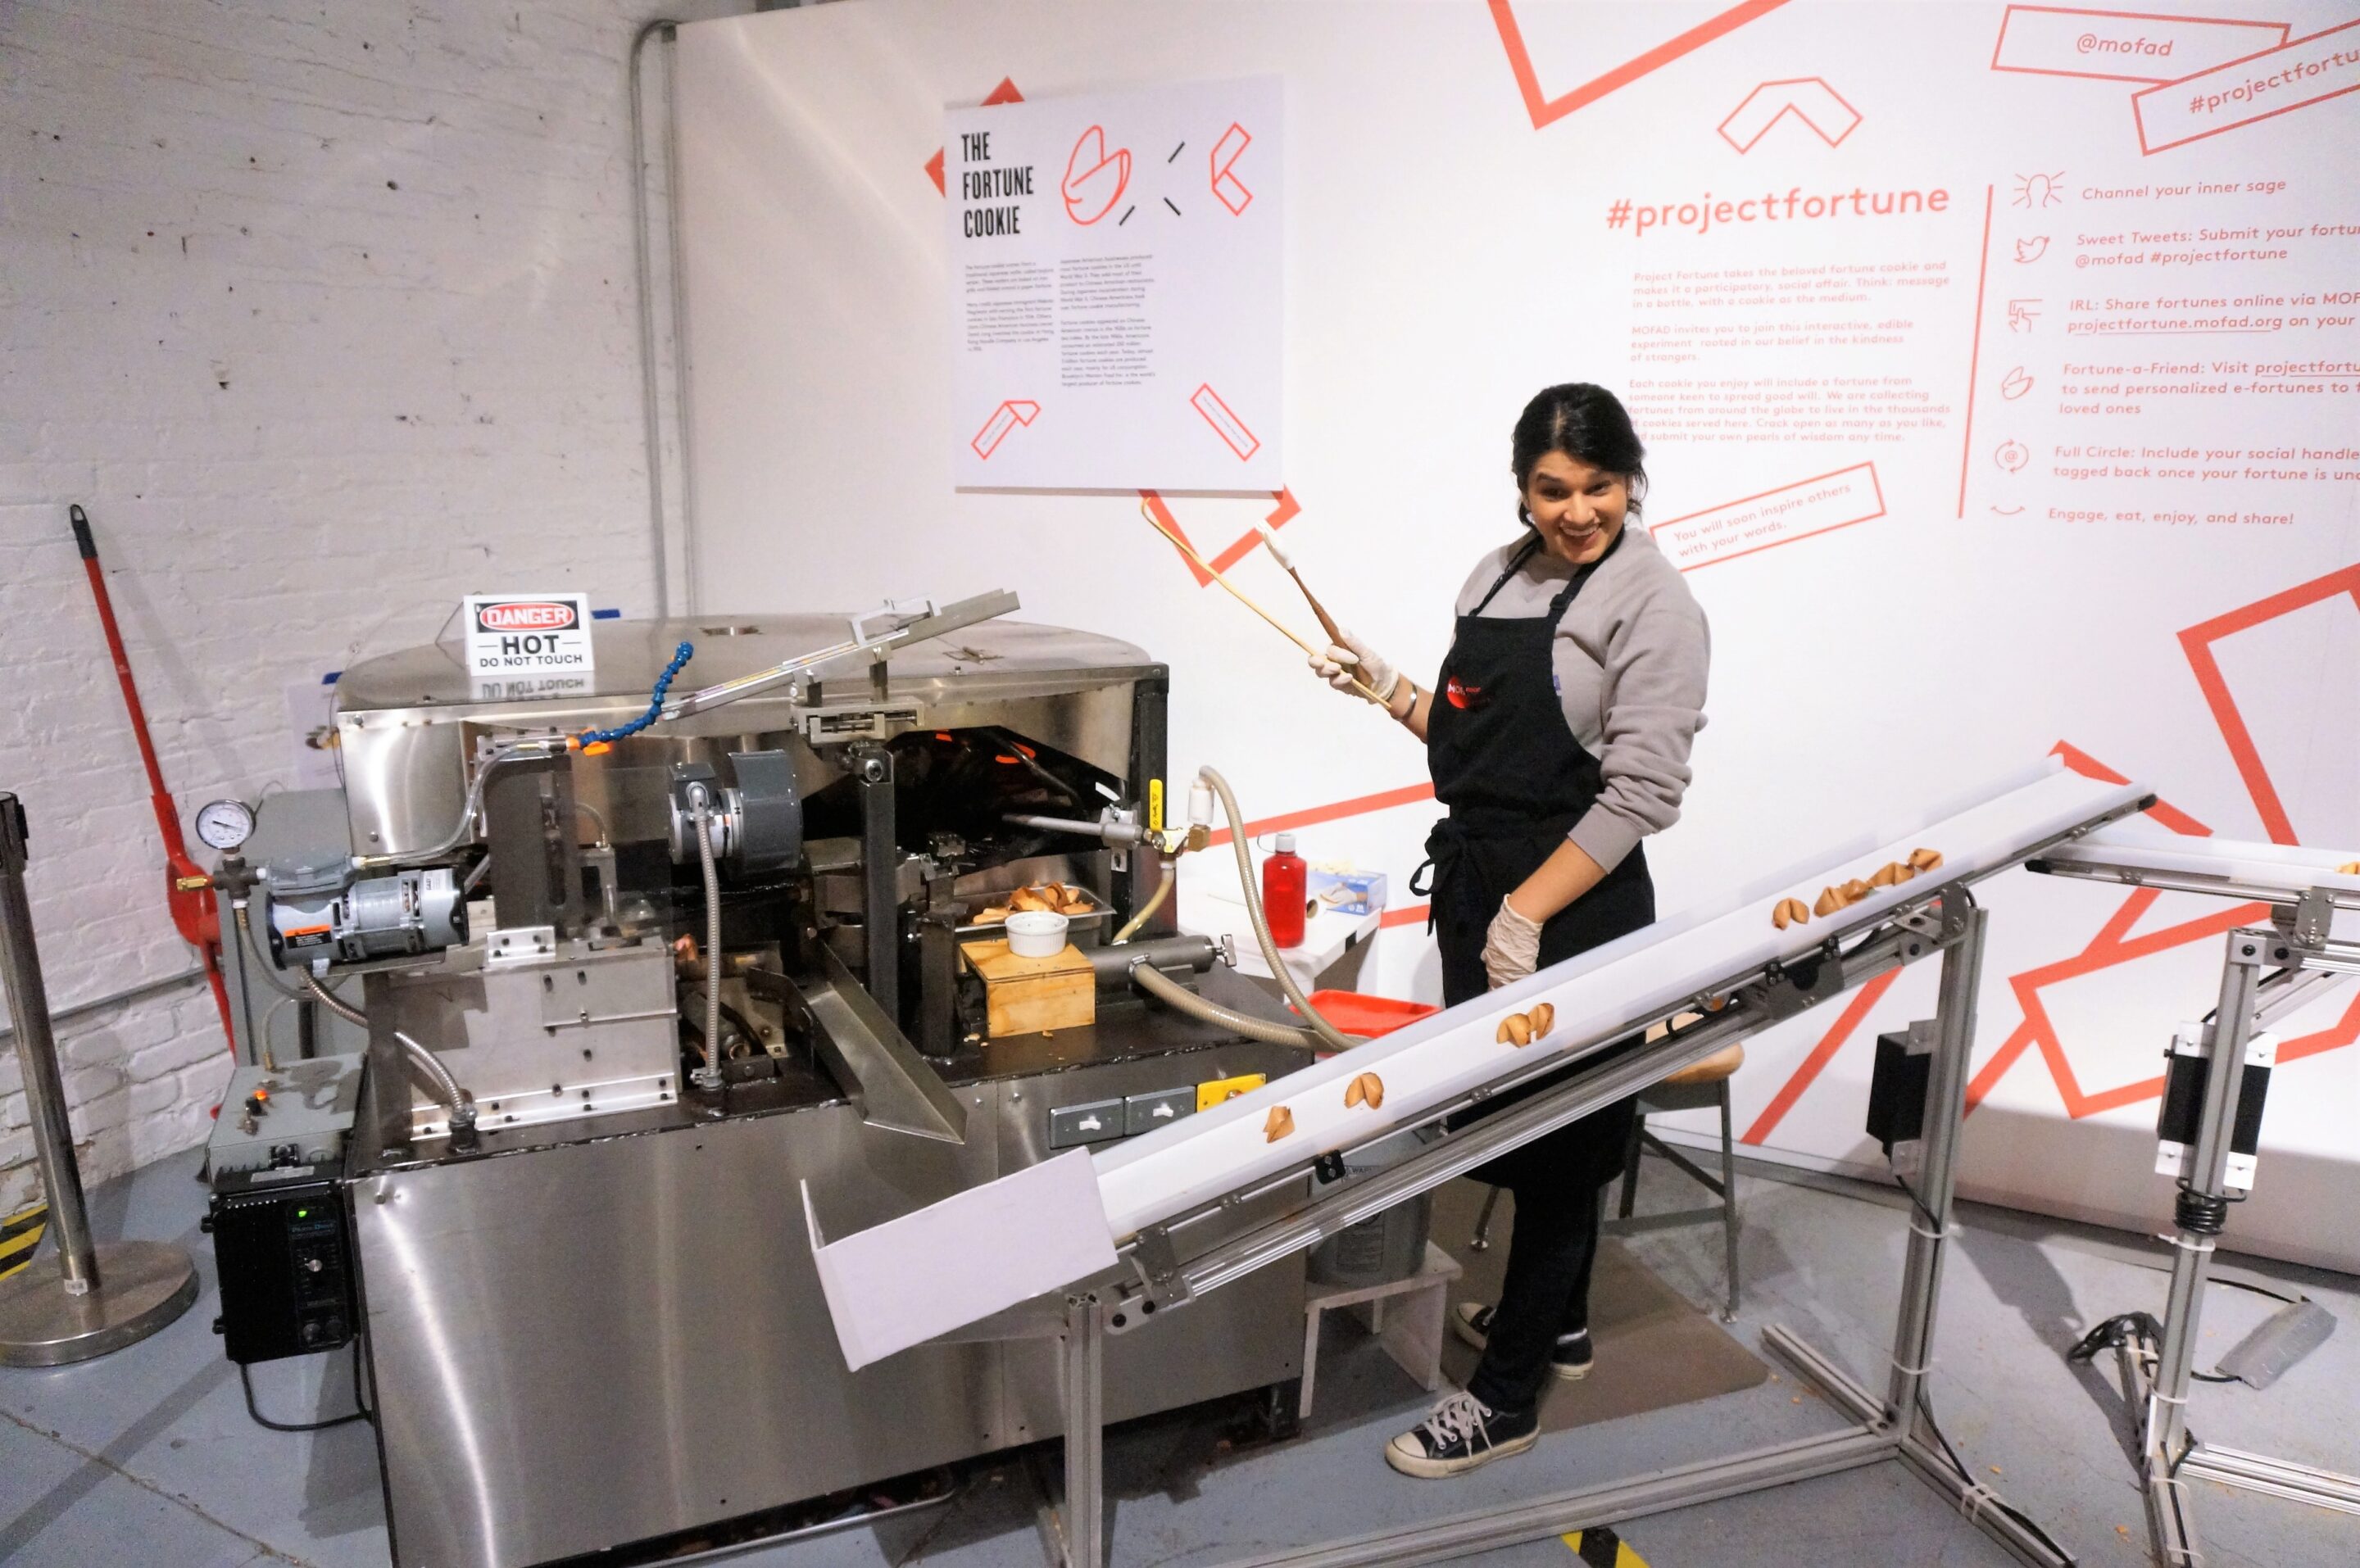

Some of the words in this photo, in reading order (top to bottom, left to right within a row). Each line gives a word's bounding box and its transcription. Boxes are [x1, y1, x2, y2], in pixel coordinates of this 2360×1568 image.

[2076, 34, 2173, 56] @mofad
[2190, 50, 2360, 113] #projectfortu
[961, 131, 991, 162] THE
[963, 165, 1033, 200] FORTUNE
[2082, 185, 2148, 199] Channel
[2155, 186, 2191, 199] your
[2198, 181, 2240, 193] inner
[2246, 181, 2285, 194] sage
[1606, 187, 1949, 237] #projectfortune
[964, 206, 1020, 238] COOKIE
[2076, 233, 2123, 245] Sweet
[2131, 231, 2191, 242] Tweets:
[2199, 227, 2258, 240] Submit
[2266, 228, 2304, 241] your
[2075, 252, 2144, 268] @mofad
[2150, 248, 2287, 265] #projectfortune
[1633, 272, 1672, 283] Project
[1677, 270, 1719, 279] Fortune
[1723, 269, 1754, 278] takes
[1758, 267, 1777, 276] the
[1781, 265, 1825, 275] beloved
[1829, 264, 1875, 273] fortune
[1879, 261, 1918, 273] cookie
[1922, 261, 1946, 271] and
[1633, 283, 1667, 295] makes
[1695, 283, 1774, 294] participatory,
[1778, 280, 1810, 289] social
[1815, 279, 1852, 288] affair.
[1857, 277, 1891, 287] Think:
[1896, 276, 1949, 288] message
[1632, 300, 1642, 308] in
[1656, 298, 1692, 307] bottle,
[1699, 297, 1723, 306] with
[1738, 295, 1775, 305] cookie
[1796, 294, 1814, 302] the
[1818, 292, 1870, 301] medium.
[2070, 299, 2098, 310] IRL:
[2105, 298, 2149, 310] Share
[2156, 297, 2226, 308] fortunes
[2233, 294, 2284, 306] online
[2290, 293, 2315, 306] via
[1631, 325, 1670, 334] MOFAD
[1674, 324, 1709, 333] invites
[1714, 326, 1734, 334] you
[1738, 324, 1750, 333] to
[1752, 324, 1774, 334] join
[1778, 321, 1800, 331] this
[1804, 320, 1872, 331] interactive,
[1877, 319, 1913, 329] edible
[2067, 315, 2282, 335] projectfortune.mofad.org
[2289, 317, 2308, 326] on
[2317, 316, 2355, 329] your
[1631, 339, 1691, 350] experiment
[1700, 337, 1737, 347] rooted
[1740, 337, 1750, 347] in
[1777, 335, 1809, 345] belief
[1814, 334, 1824, 344] in
[1828, 335, 1848, 344] the
[1851, 333, 1904, 344] kindness
[1630, 352, 1641, 362] of
[1645, 353, 1699, 363] strangers.
[2063, 362, 2204, 374] Fortune-a-Friend:
[2212, 361, 2249, 373] Visit
[1629, 378, 1654, 387] Each
[1658, 378, 1692, 387] cookie
[1697, 380, 1716, 389] you
[1719, 378, 1749, 389] enjoy
[1754, 378, 1772, 387] will
[1777, 377, 1818, 387] include
[1832, 376, 1878, 386] fortune
[1881, 376, 1911, 385] from
[2062, 385, 2076, 393] to
[2084, 383, 2119, 393] send
[2125, 382, 2227, 397] personalized
[2233, 381, 2323, 393] e-fortunes
[2330, 383, 2349, 392] to
[1724, 392, 1760, 402] spread
[1765, 392, 1793, 402] good
[1797, 391, 1819, 400] will.
[1827, 391, 1842, 399] We
[1870, 389, 1929, 401] collecting
[1628, 405, 1673, 415] fortunes
[1678, 406, 1704, 414] from
[1773, 406, 1804, 416] globe
[1863, 405, 1882, 413] the
[1887, 404, 1950, 414] thousands
[2058, 402, 2099, 414] loved
[2105, 405, 2140, 414] ones
[1643, 419, 1682, 427] cookies
[1685, 419, 1720, 427] served
[1724, 419, 1750, 427] here.
[1756, 418, 1788, 427] Crack
[1793, 420, 1820, 429] open
[1842, 420, 1873, 428] many
[1896, 420, 1917, 429] you
[1922, 417, 1945, 428] like,
[1650, 432, 1687, 440] submit
[1691, 433, 1714, 442] your
[1746, 432, 1779, 442] pearls
[1783, 432, 1795, 441] of
[1800, 432, 1844, 441] wisdom
[1847, 433, 1870, 442] any
[1873, 432, 1904, 441] time.
[2055, 446, 2080, 456] Full
[2086, 446, 2134, 457] Circle:
[2141, 446, 2199, 458] Include
[2205, 450, 2241, 461] your
[2248, 447, 2294, 459] social
[2302, 447, 2360, 460] handle
[2054, 466, 2108, 479] tagged
[2113, 465, 2150, 477] back
[2158, 469, 2194, 478] once
[2202, 470, 2237, 481] your
[2244, 467, 2308, 479] fortune
[2314, 467, 2326, 479] is
[1673, 530, 1696, 541] You
[1700, 519, 1722, 533] will
[1727, 513, 1756, 527] soon
[1760, 498, 1803, 516] inspire
[1808, 484, 1850, 503] others
[2048, 507, 2107, 523] Engage,
[2115, 511, 2144, 522] eat,
[2153, 510, 2197, 525] enjoy,
[2206, 511, 2237, 523] and
[2243, 512, 2293, 524] share!
[1678, 542, 1707, 556] with
[1711, 534, 1737, 551] your
[1744, 521, 1786, 537] words.
[487, 607, 568, 626] DANGER
[502, 635, 559, 655] HOT
[480, 658, 498, 667] DO
[504, 656, 531, 666] NOT
[536, 655, 583, 664] TOUCH
